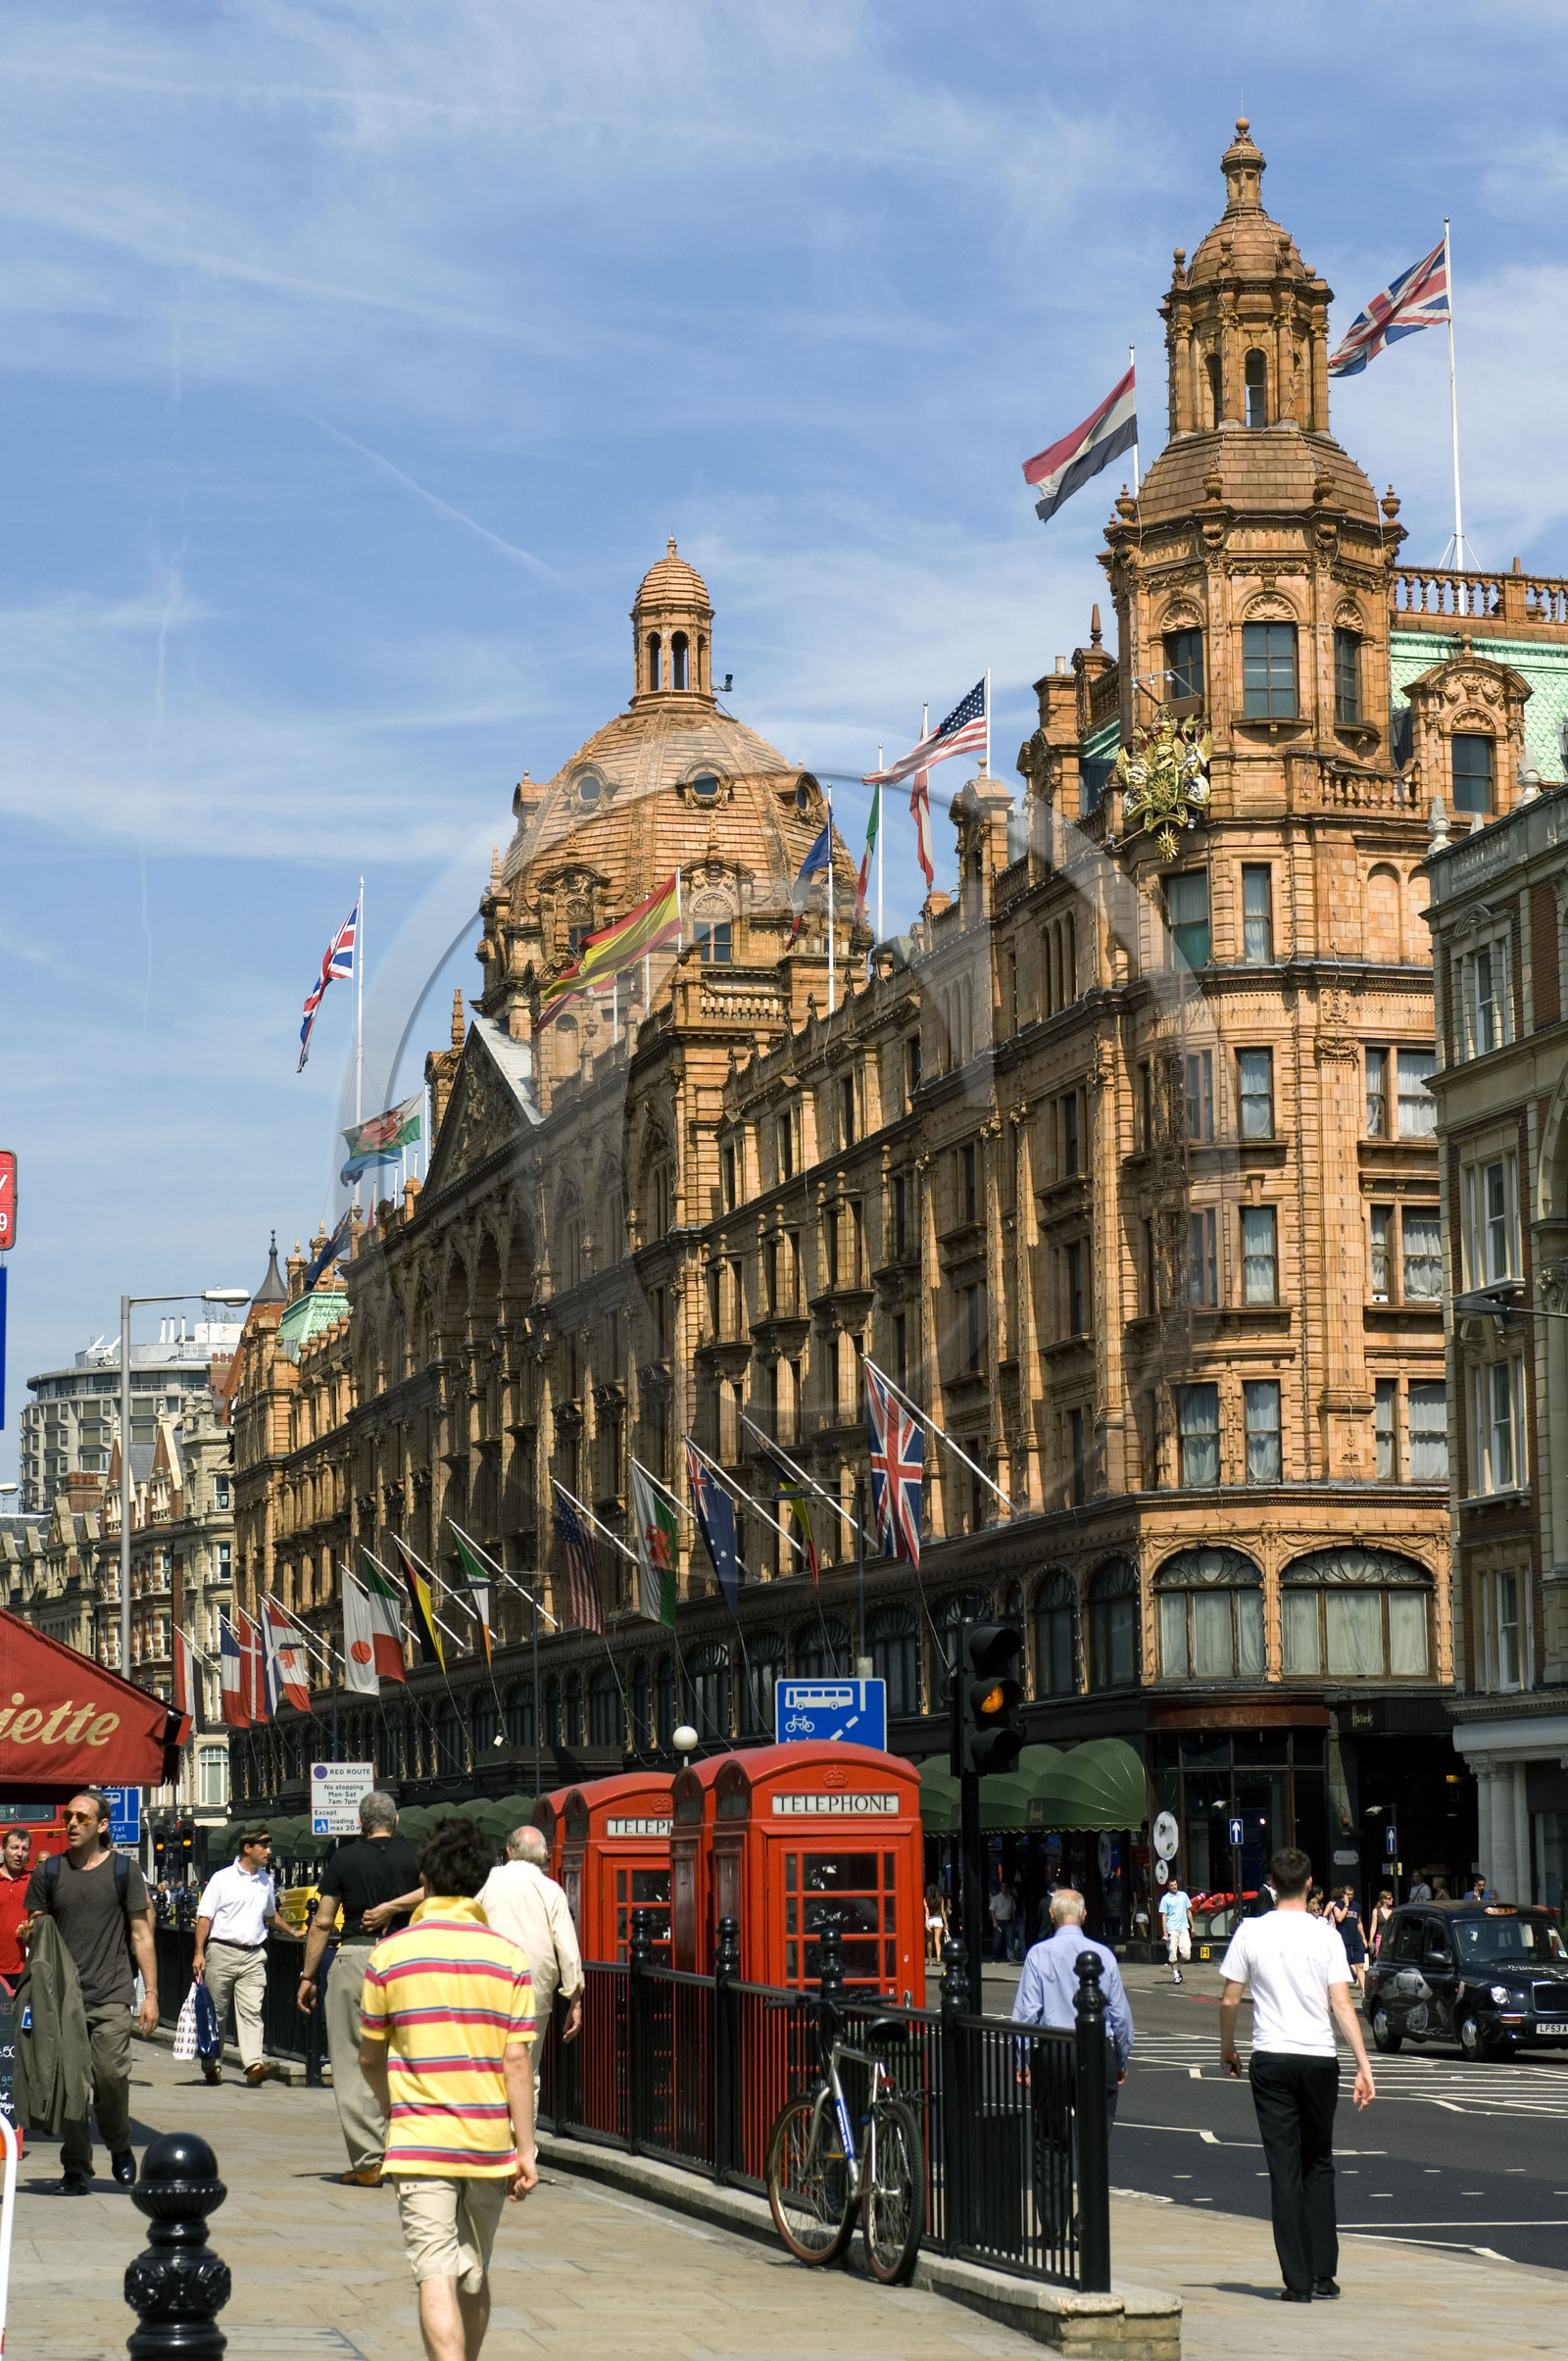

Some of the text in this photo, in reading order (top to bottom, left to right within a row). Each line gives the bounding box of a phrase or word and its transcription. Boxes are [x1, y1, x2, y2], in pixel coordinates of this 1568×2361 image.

[775, 1795, 895, 1812] TELEPHONE
[611, 1819, 671, 1834] TELEP
[1540, 2024, 1561, 2033] LF53
